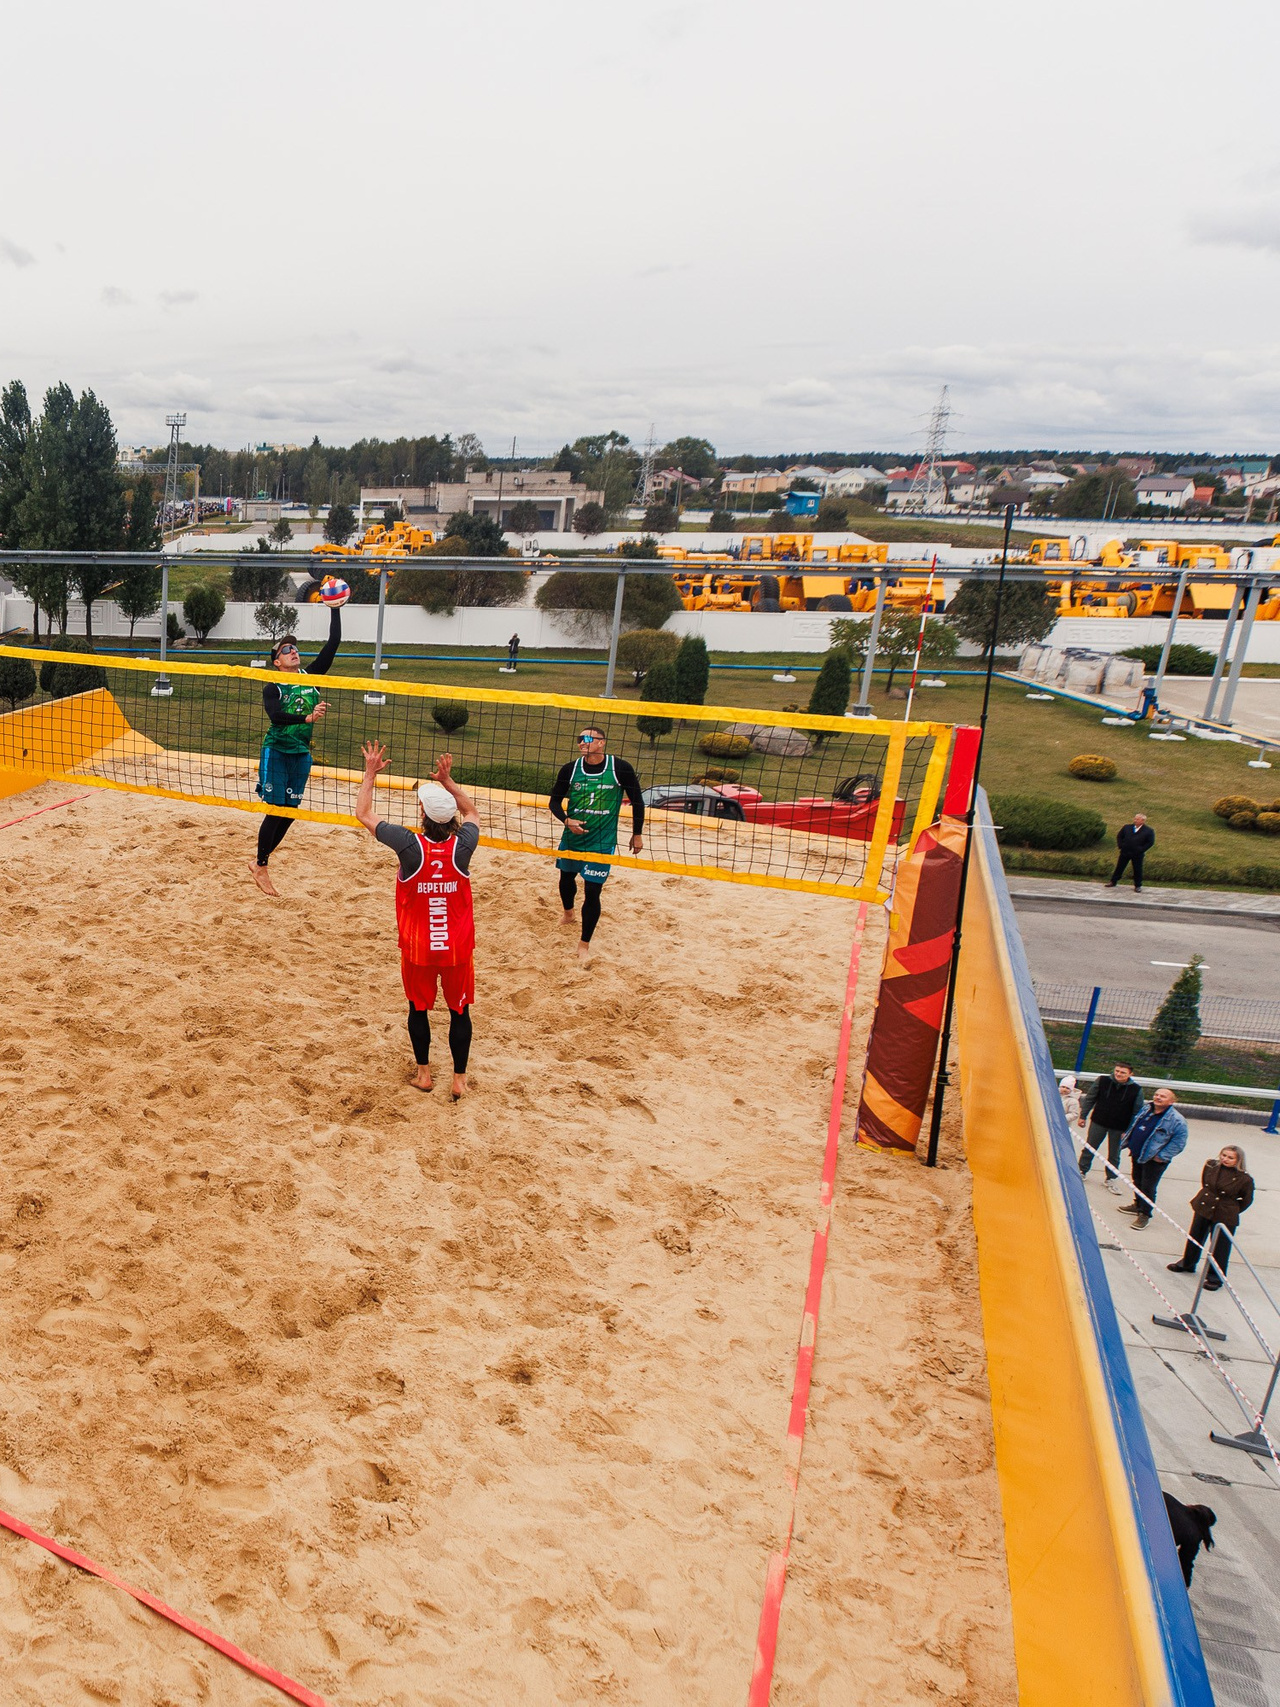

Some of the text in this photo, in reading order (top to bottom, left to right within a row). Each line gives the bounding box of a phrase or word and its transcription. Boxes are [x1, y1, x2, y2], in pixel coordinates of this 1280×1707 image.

[430, 860, 443, 879] 2
[417, 881, 458, 894] ВЕРЕТЮК
[429, 897, 449, 951] РОССИЯ
